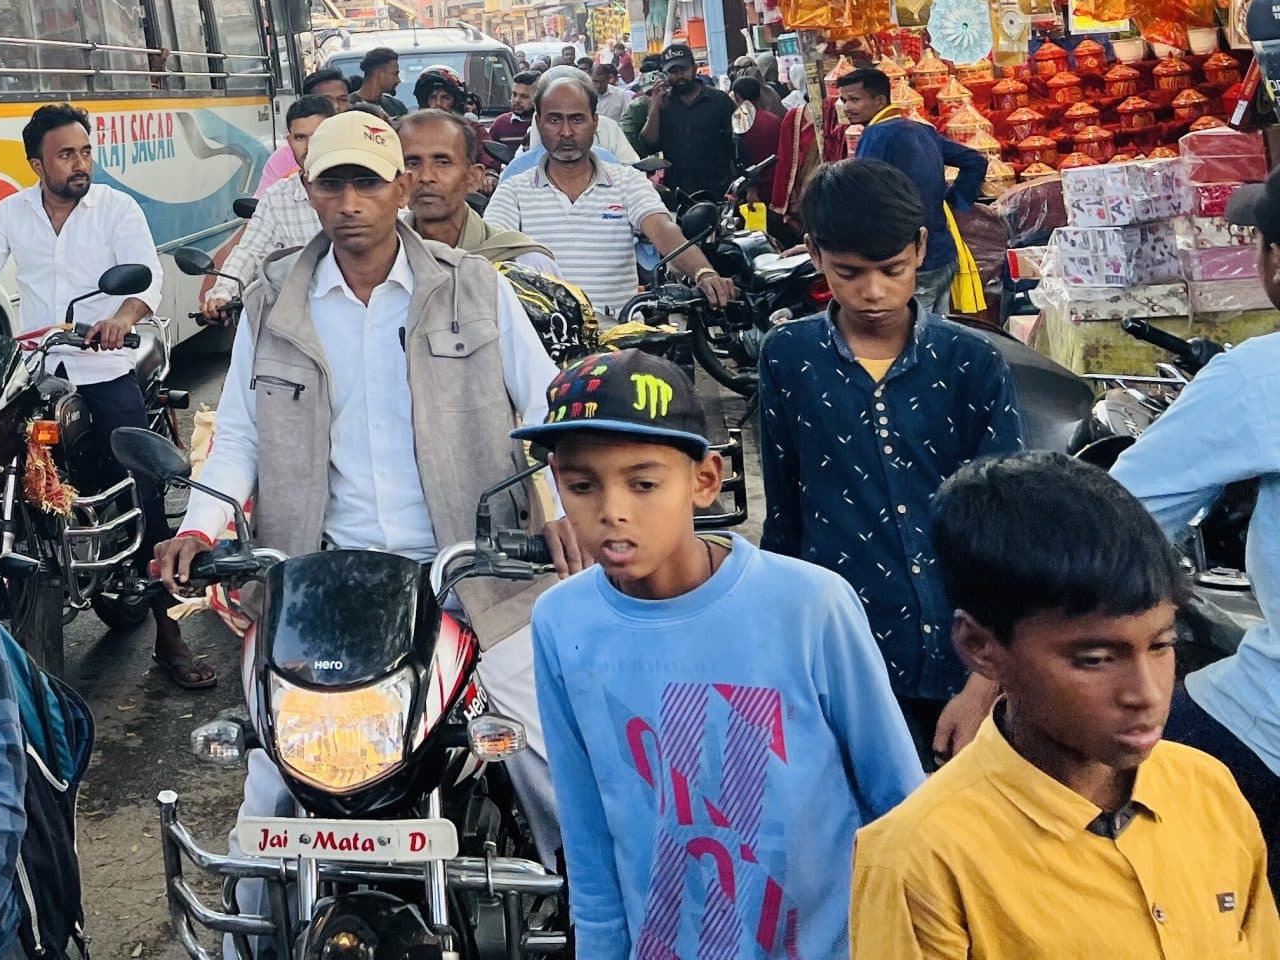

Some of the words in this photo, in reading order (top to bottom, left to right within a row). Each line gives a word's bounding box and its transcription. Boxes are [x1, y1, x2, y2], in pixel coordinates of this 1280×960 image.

[96, 115, 126, 174] RAJ
[131, 112, 175, 164] SAGAR
[258, 828, 288, 852] Jai
[312, 831, 376, 852] Mata
